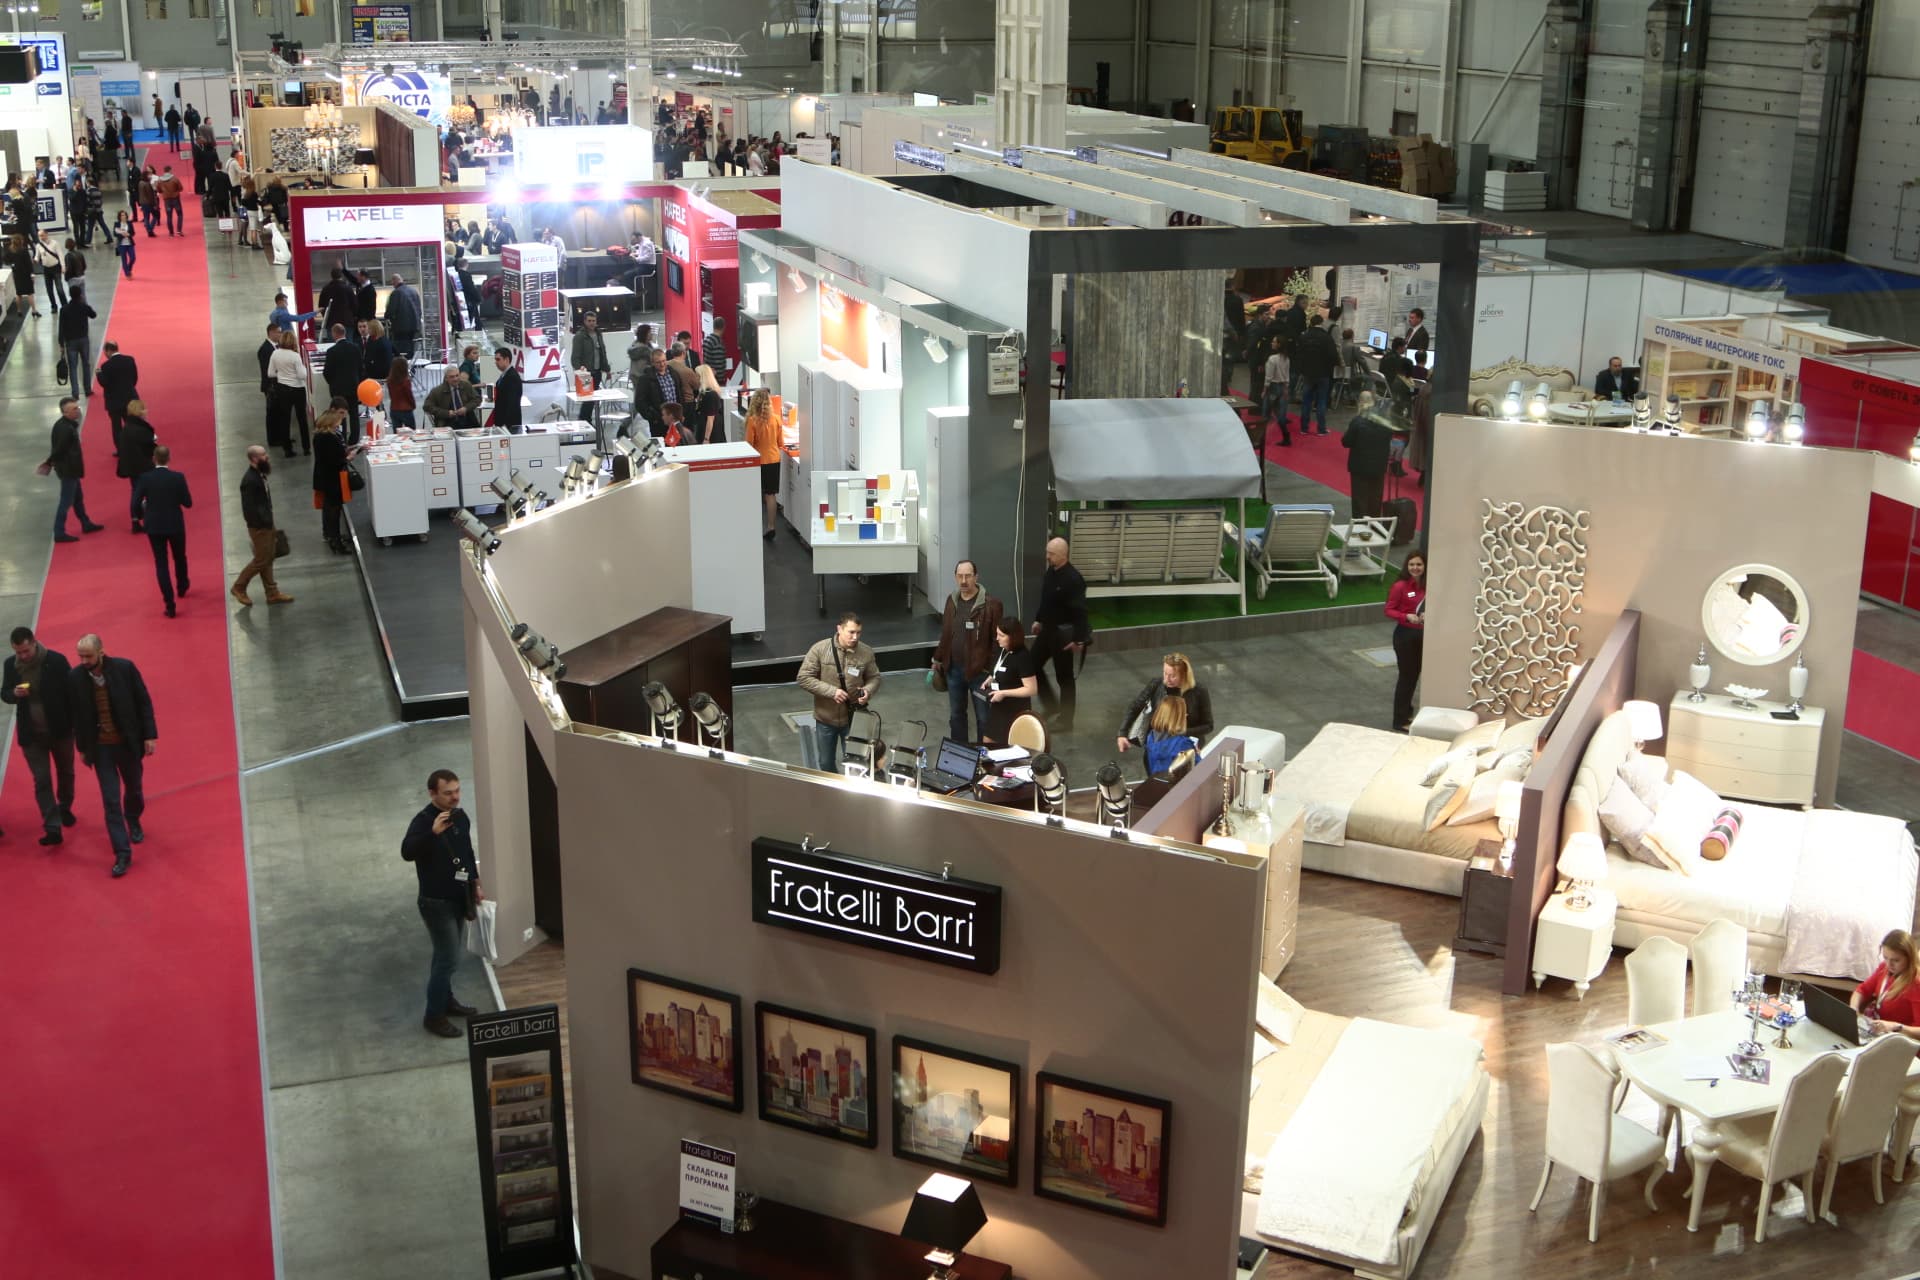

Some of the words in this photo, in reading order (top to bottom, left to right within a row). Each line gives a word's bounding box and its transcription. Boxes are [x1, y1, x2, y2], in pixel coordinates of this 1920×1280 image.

[326, 207, 404, 222] HÄFELE
[1654, 325, 1703, 347] СТОЛЯРНЫЕ
[1705, 338, 1760, 362] МАСТЕРСКИЕ
[1762, 354, 1786, 370] ТОКС
[769, 869, 881, 927] Fratelli
[895, 895, 974, 948] Barri
[472, 1020, 520, 1041] Fratelli
[523, 1015, 556, 1033] Barri
[684, 1173, 730, 1192] ПРОГРАММА
[686, 1163, 729, 1180] СКЛАДСКАЯ
